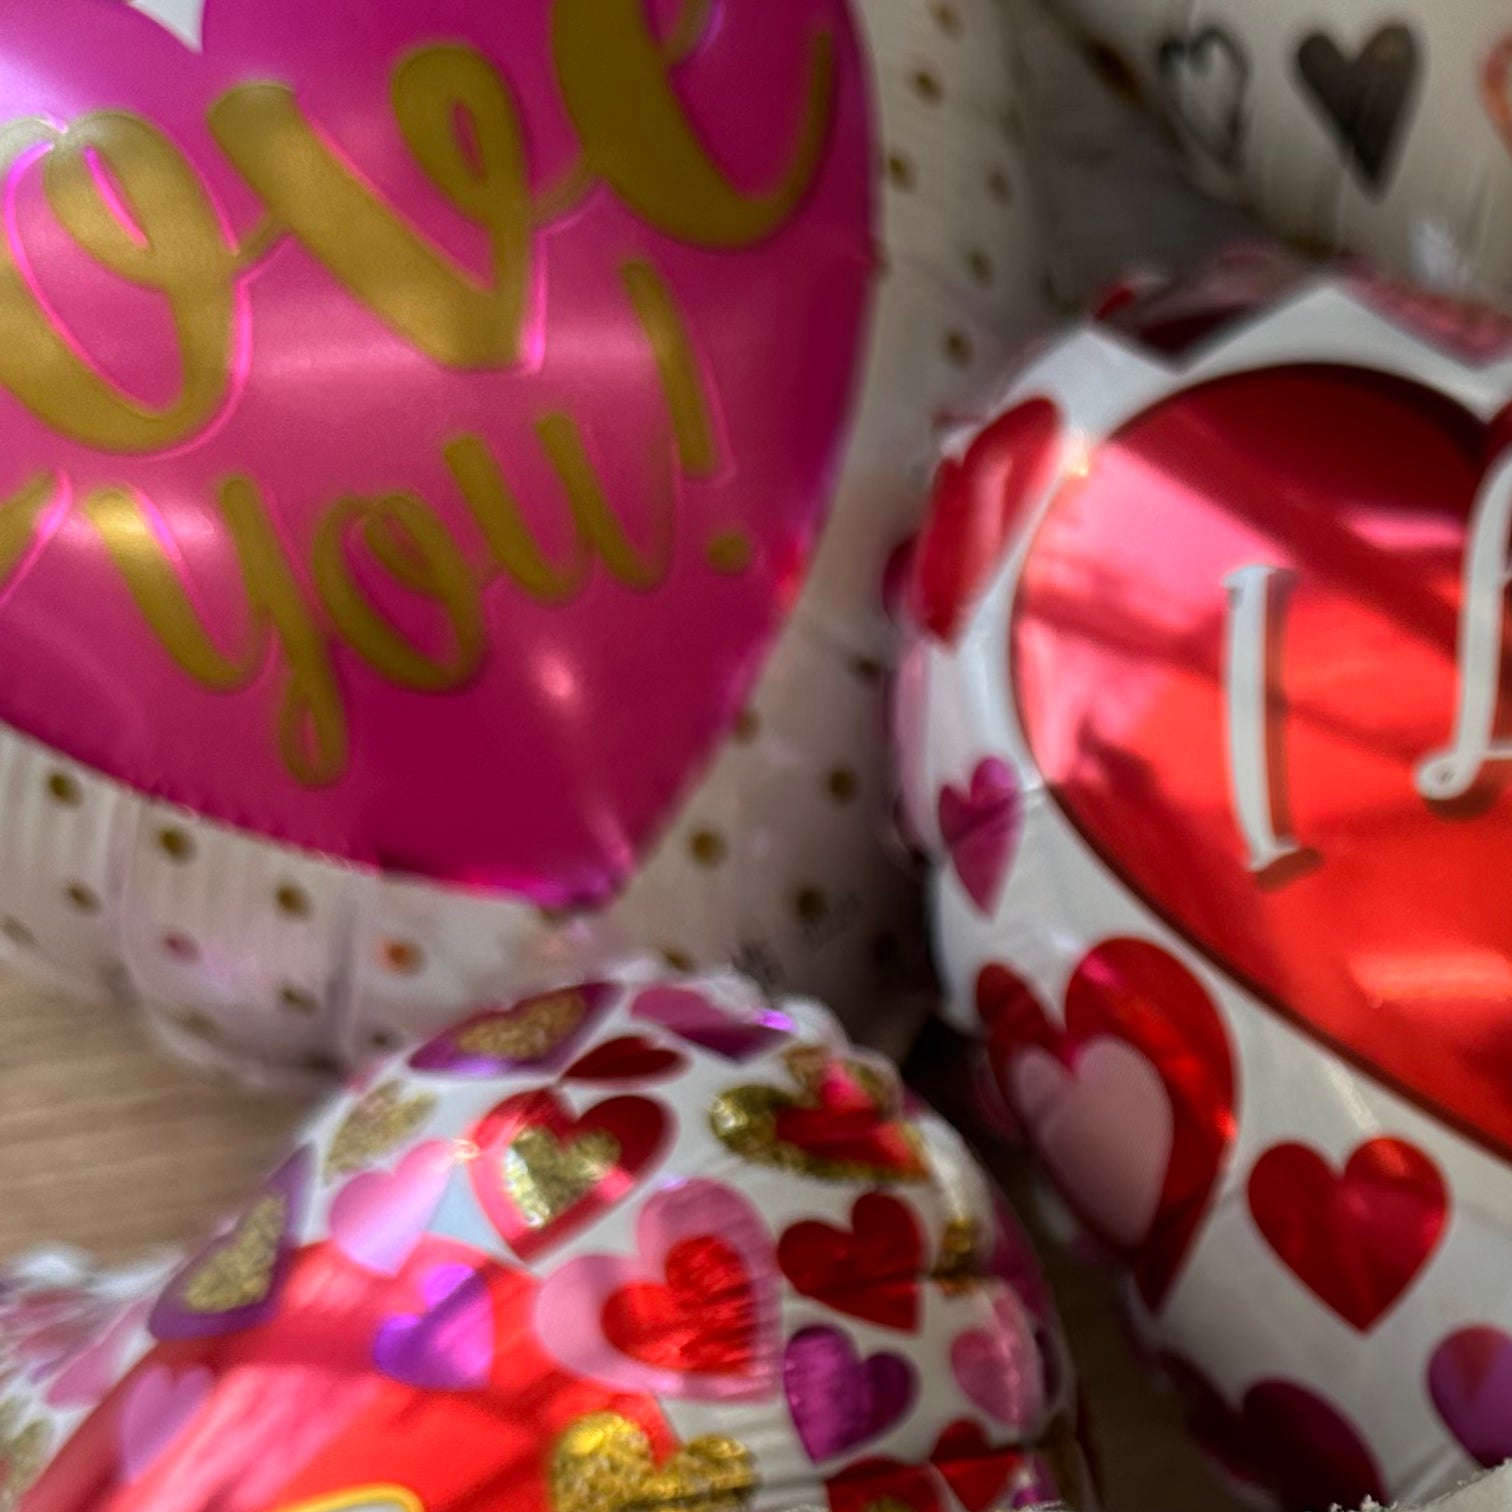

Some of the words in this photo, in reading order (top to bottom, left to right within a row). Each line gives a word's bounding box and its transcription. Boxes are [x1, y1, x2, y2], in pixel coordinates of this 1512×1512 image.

[0, 0, 840, 456] ove
[84, 257, 752, 788] you!
[1223, 563, 1302, 873] I
